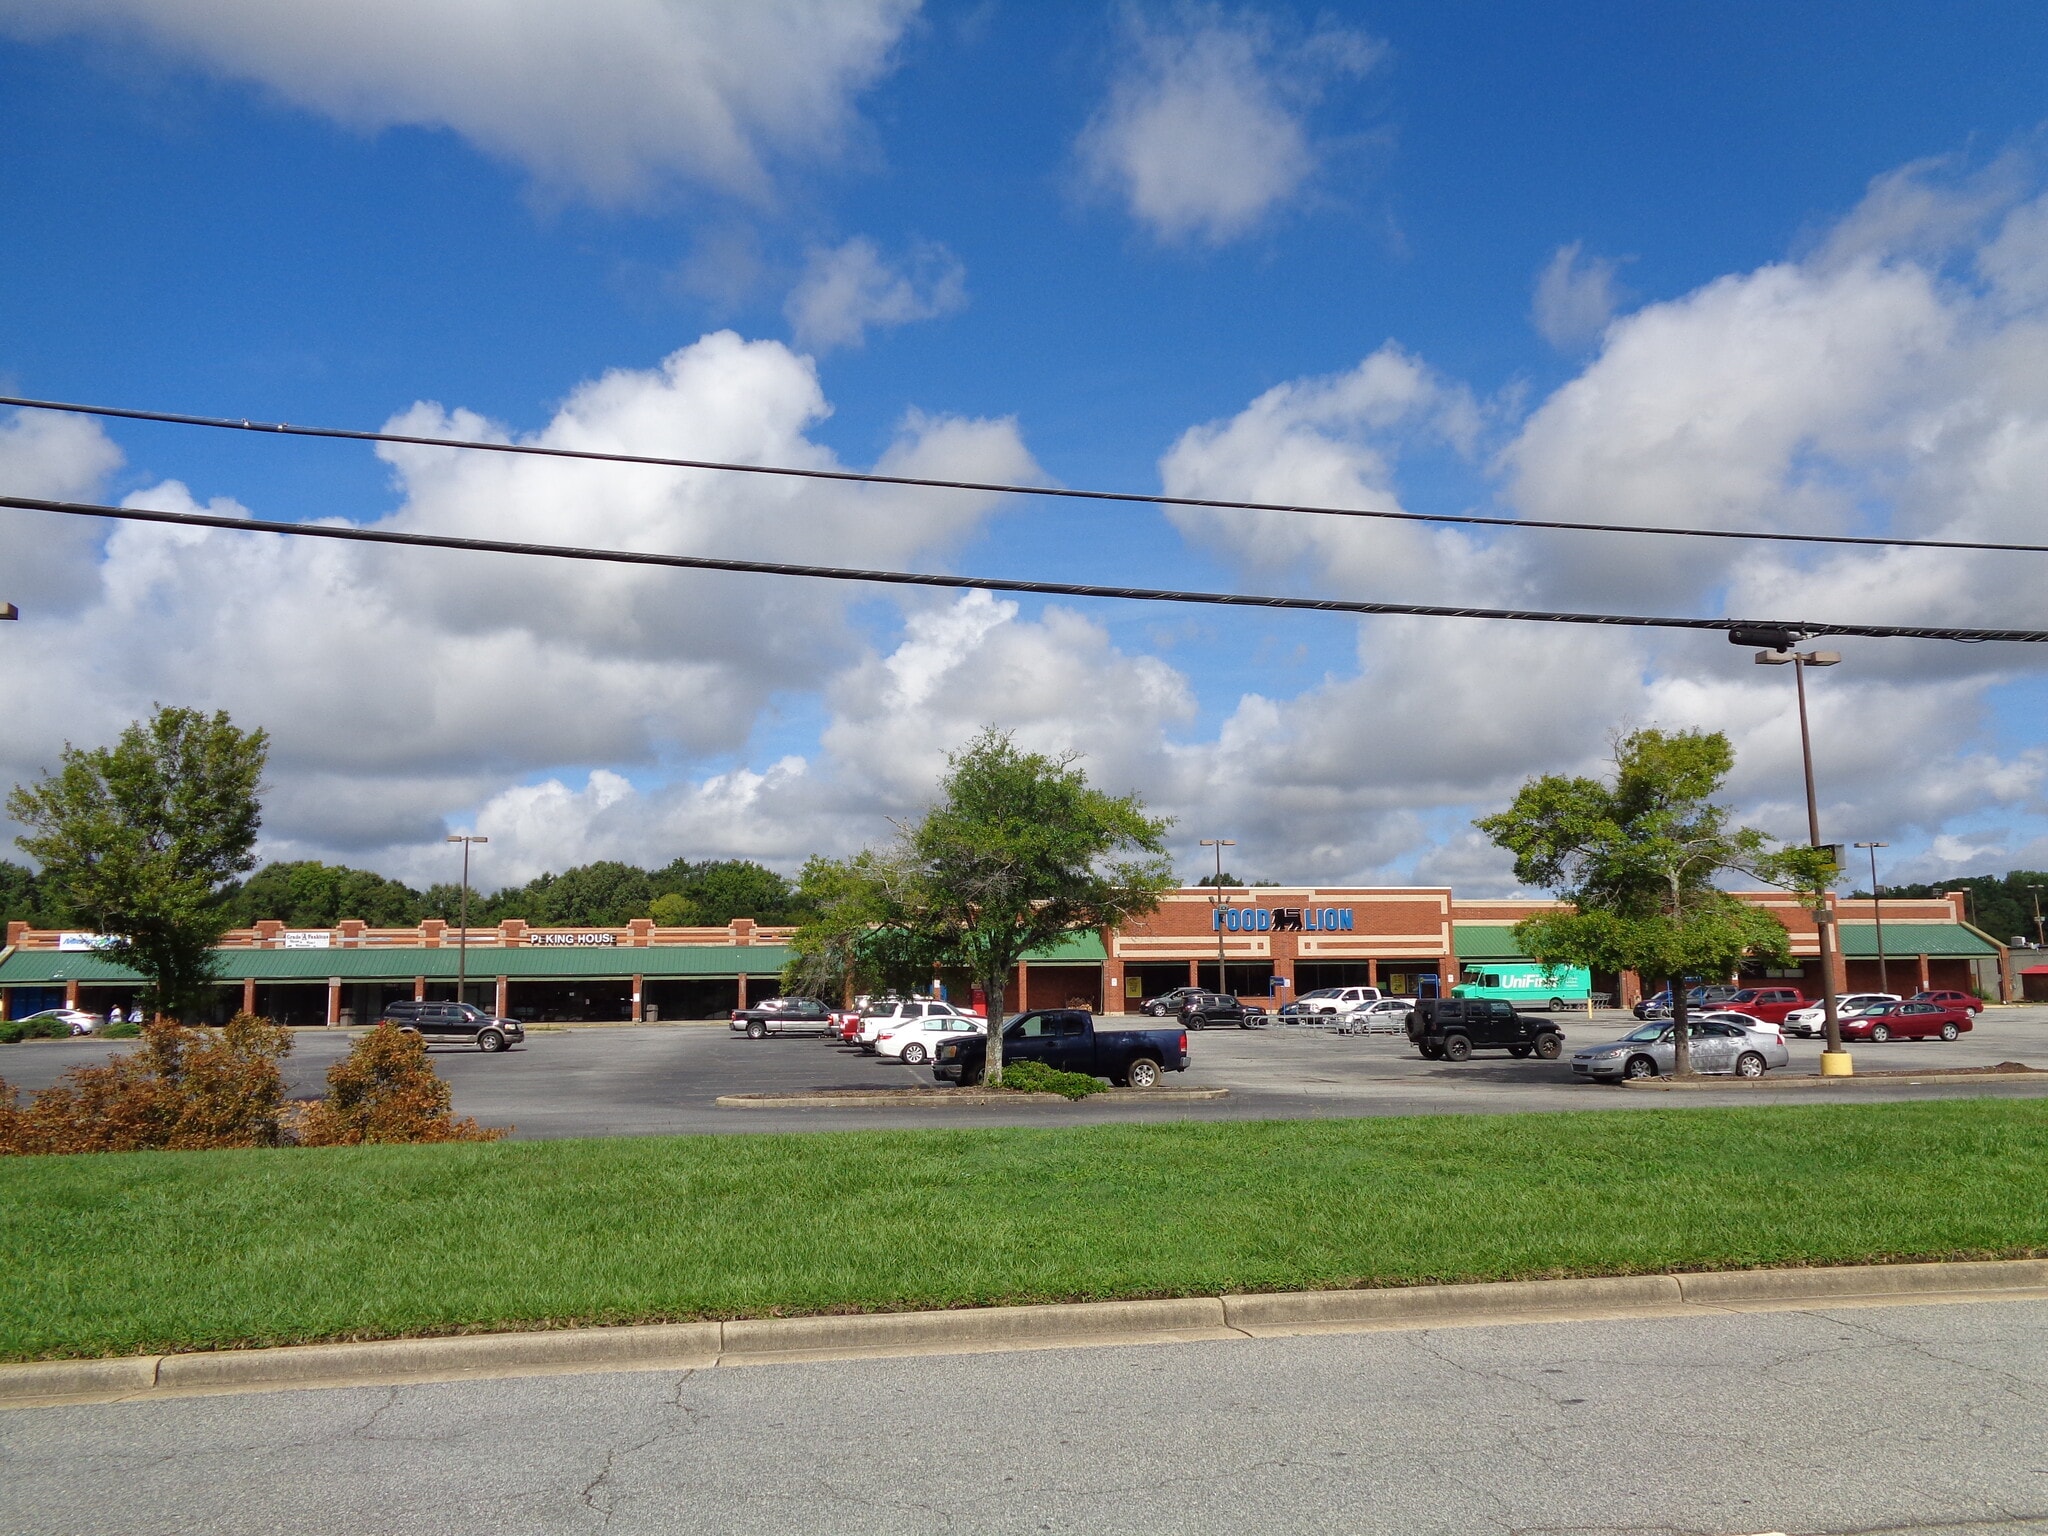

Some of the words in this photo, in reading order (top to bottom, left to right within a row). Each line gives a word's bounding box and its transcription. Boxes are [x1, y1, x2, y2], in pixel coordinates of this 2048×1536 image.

[1212, 908, 1271, 931] FOOD
[1304, 907, 1353, 931] LION
[531, 934, 574, 944] PEKING
[577, 933, 617, 944] HOUSE
[1501, 974, 1558, 989] UniFir
